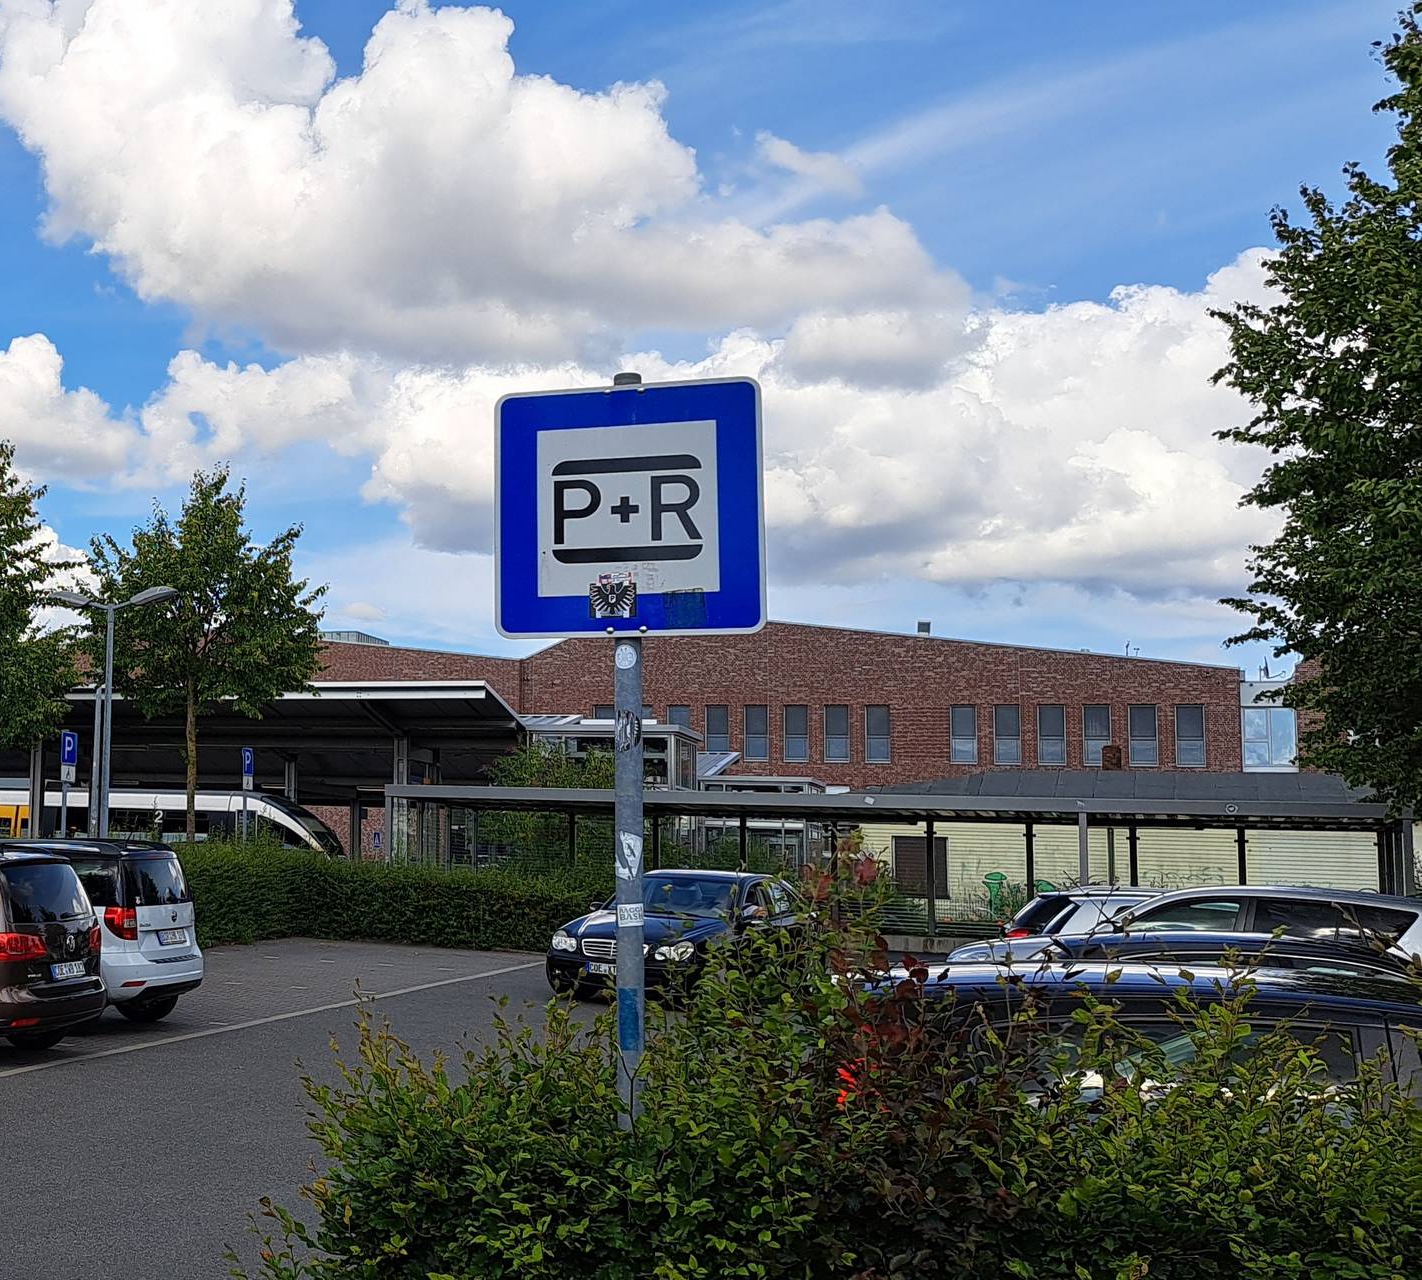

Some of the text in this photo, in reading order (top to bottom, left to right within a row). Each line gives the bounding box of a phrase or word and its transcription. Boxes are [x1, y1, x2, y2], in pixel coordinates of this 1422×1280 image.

[554, 475, 703, 545] P+R
[64, 736, 74, 760] P
[244, 751, 252, 772] P
[154, 810, 164, 823] 2
